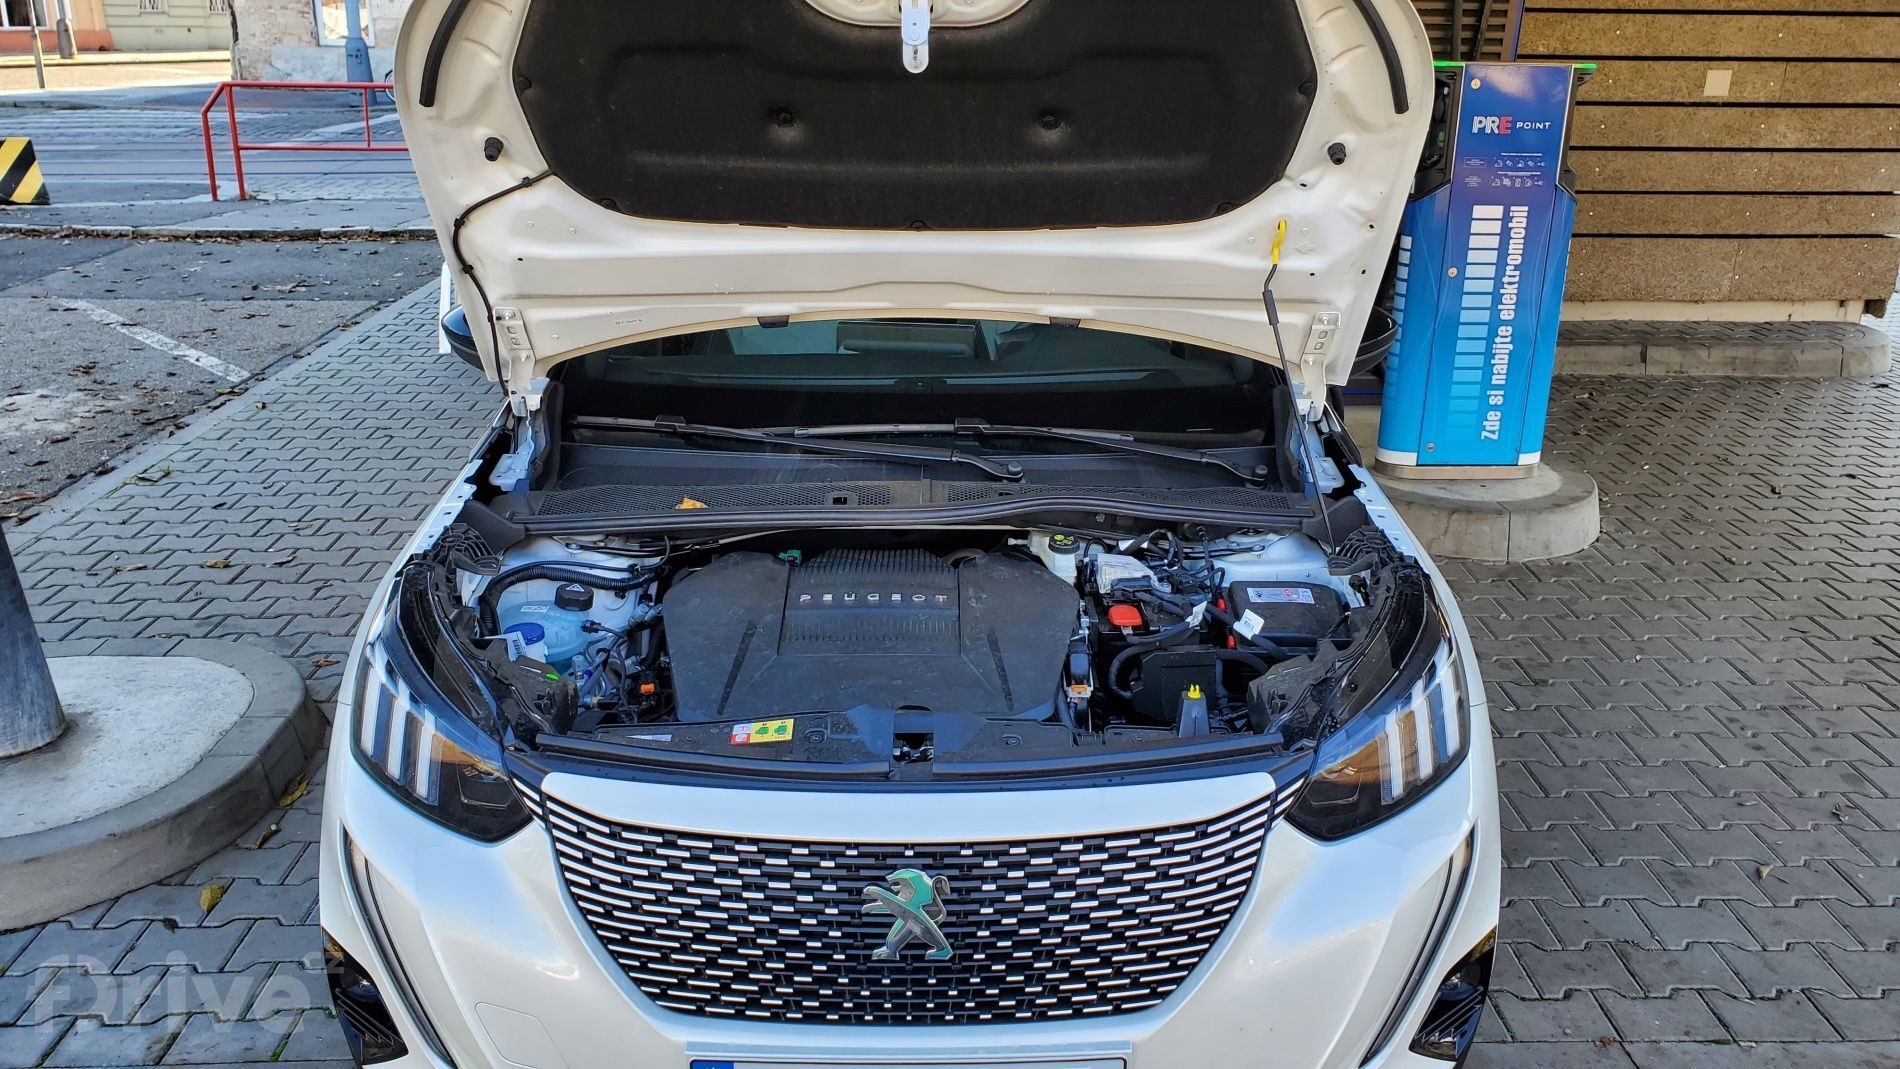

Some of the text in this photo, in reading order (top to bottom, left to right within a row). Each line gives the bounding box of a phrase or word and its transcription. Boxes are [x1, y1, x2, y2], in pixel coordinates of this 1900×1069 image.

[1472, 116, 1513, 134] PRE
[1481, 206, 1529, 440] Zde si nabijte elektromobil
[800, 593, 948, 602] PEUGEOT
